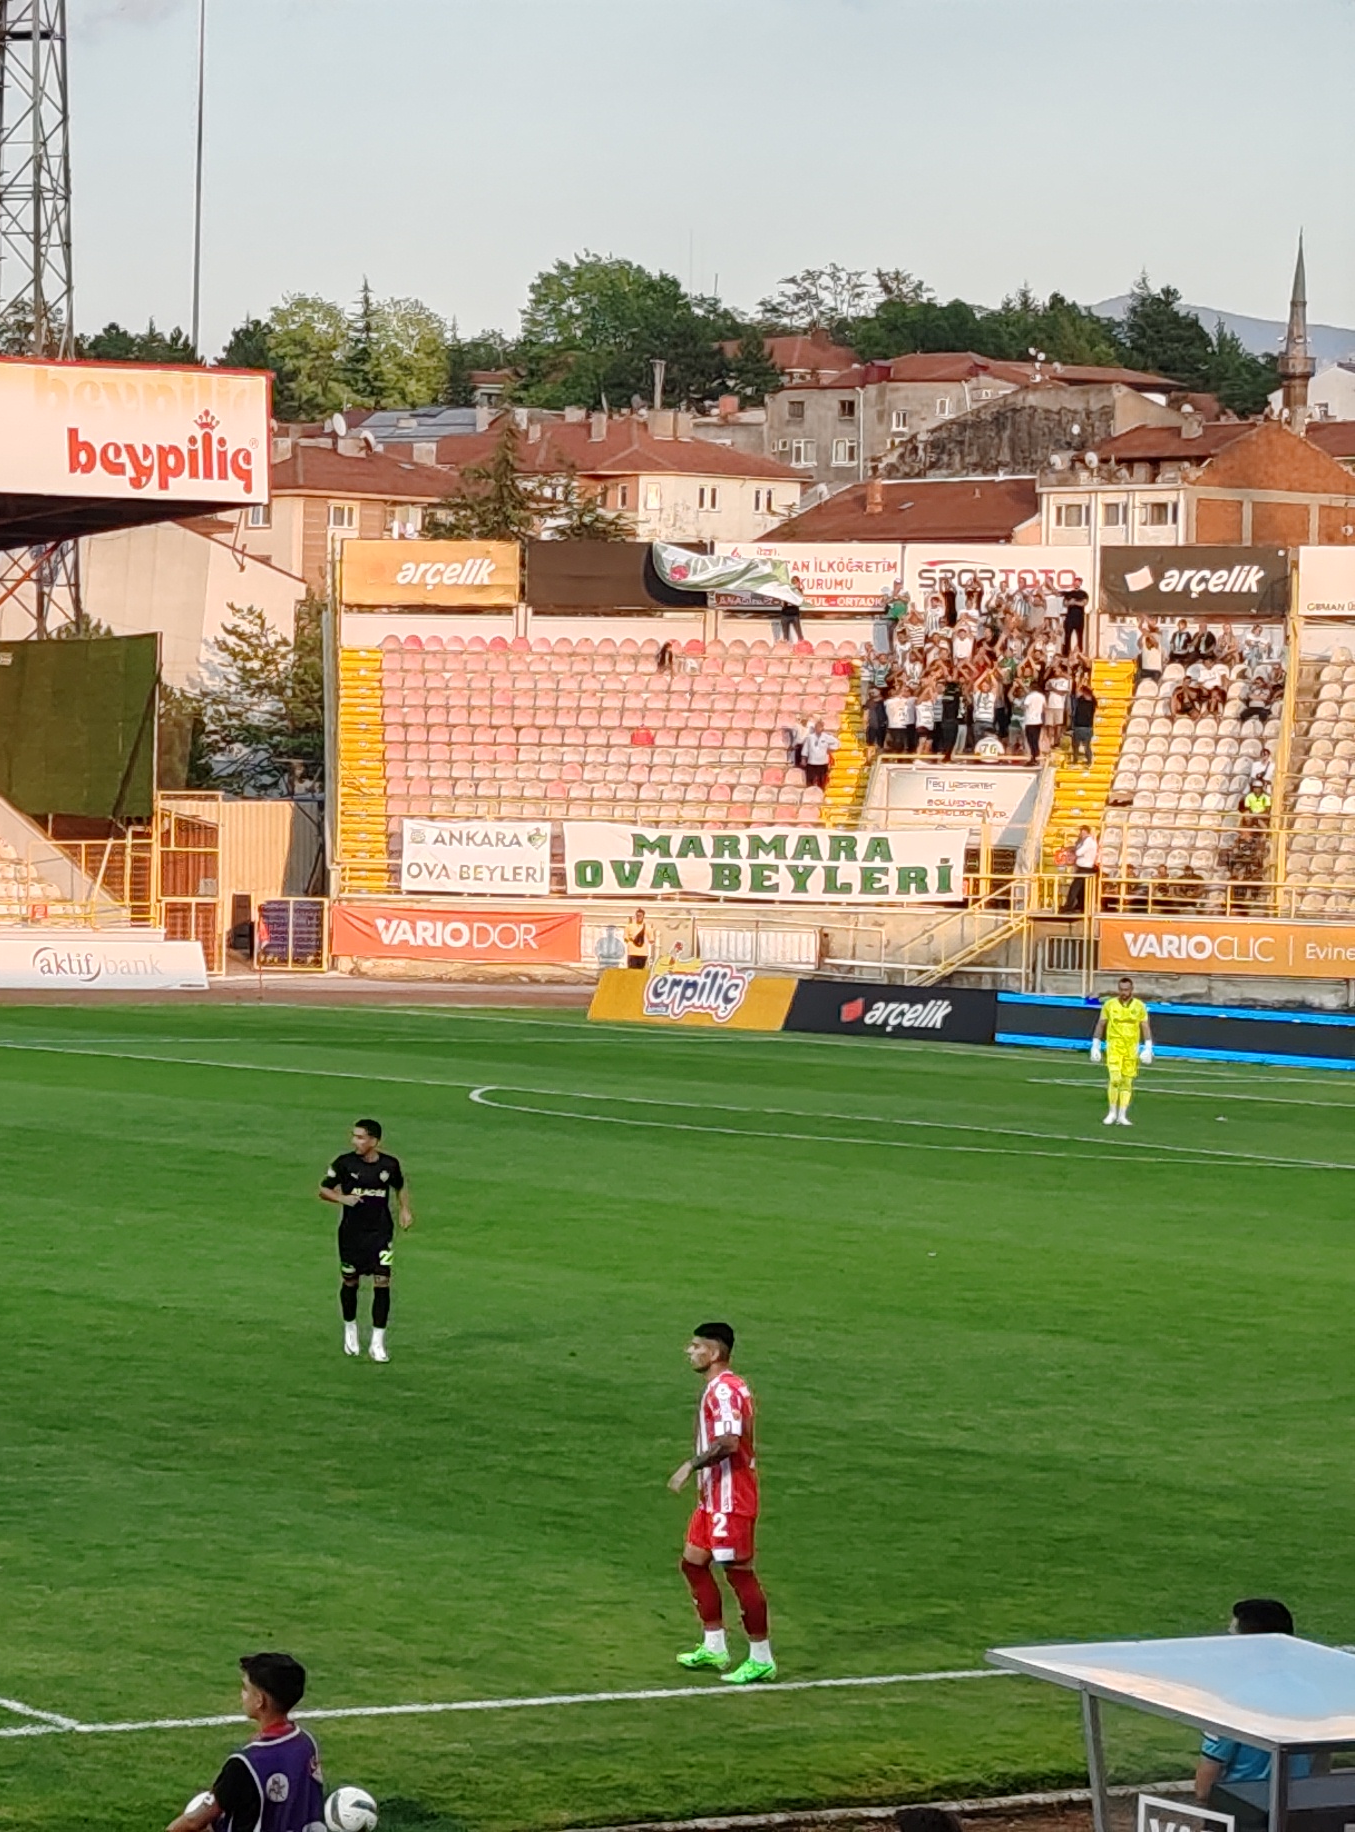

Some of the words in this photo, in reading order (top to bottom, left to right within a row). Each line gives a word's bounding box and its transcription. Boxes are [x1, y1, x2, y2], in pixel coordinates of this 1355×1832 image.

[396, 558, 496, 590] arçelik
[814, 556, 898, 573] İLKÖĞRETİM
[1158, 564, 1265, 599] arçelik
[432, 829, 523, 848] ANKARA
[631, 833, 894, 863] MARMARA
[406, 862, 451, 880] OVA
[458, 861, 545, 884] BEYLERİ
[574, 859, 683, 889] OVA
[709, 858, 954, 895] BEYLERİ
[40, 952, 95, 976] aktif
[102, 955, 164, 977] bank
[651, 969, 740, 1013] erpiliç
[863, 999, 953, 1032] arçelik
[712, 1513, 728, 1537] 2
